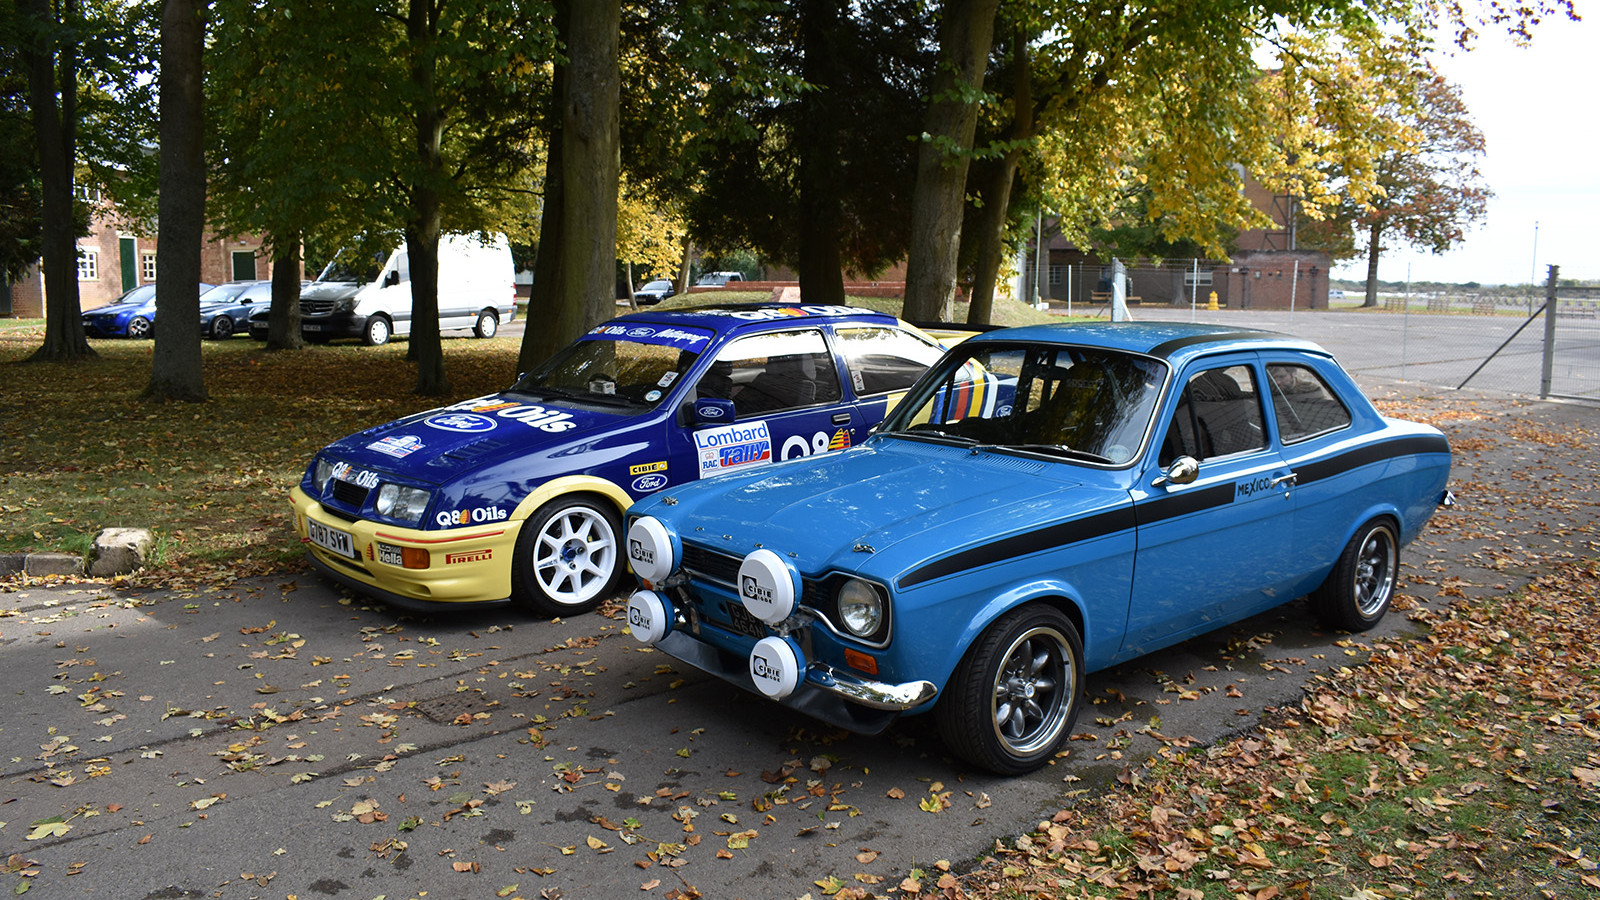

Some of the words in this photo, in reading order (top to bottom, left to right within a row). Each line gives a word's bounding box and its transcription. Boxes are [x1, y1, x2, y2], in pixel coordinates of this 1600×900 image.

[731, 308, 788, 320] Q8
[801, 306, 875, 316] Oils
[604, 326, 626, 335] Oils
[497, 405, 576, 432] Oils
[702, 407, 720, 416] Ford
[430, 414, 490, 430] Ford
[695, 423, 768, 448] Lombard
[702, 460, 718, 470] RAC
[723, 440, 768, 465] rally
[781, 431, 830, 461] Q8
[332, 461, 349, 478] Q8
[356, 470, 380, 489] Oils
[637, 476, 662, 490] Ford
[1237, 477, 1270, 497] MEXICO
[436, 509, 460, 526] Q8
[472, 506, 507, 522] Oils
[378, 550, 403, 565] Hella
[445, 549, 492, 564] PIRELLI
